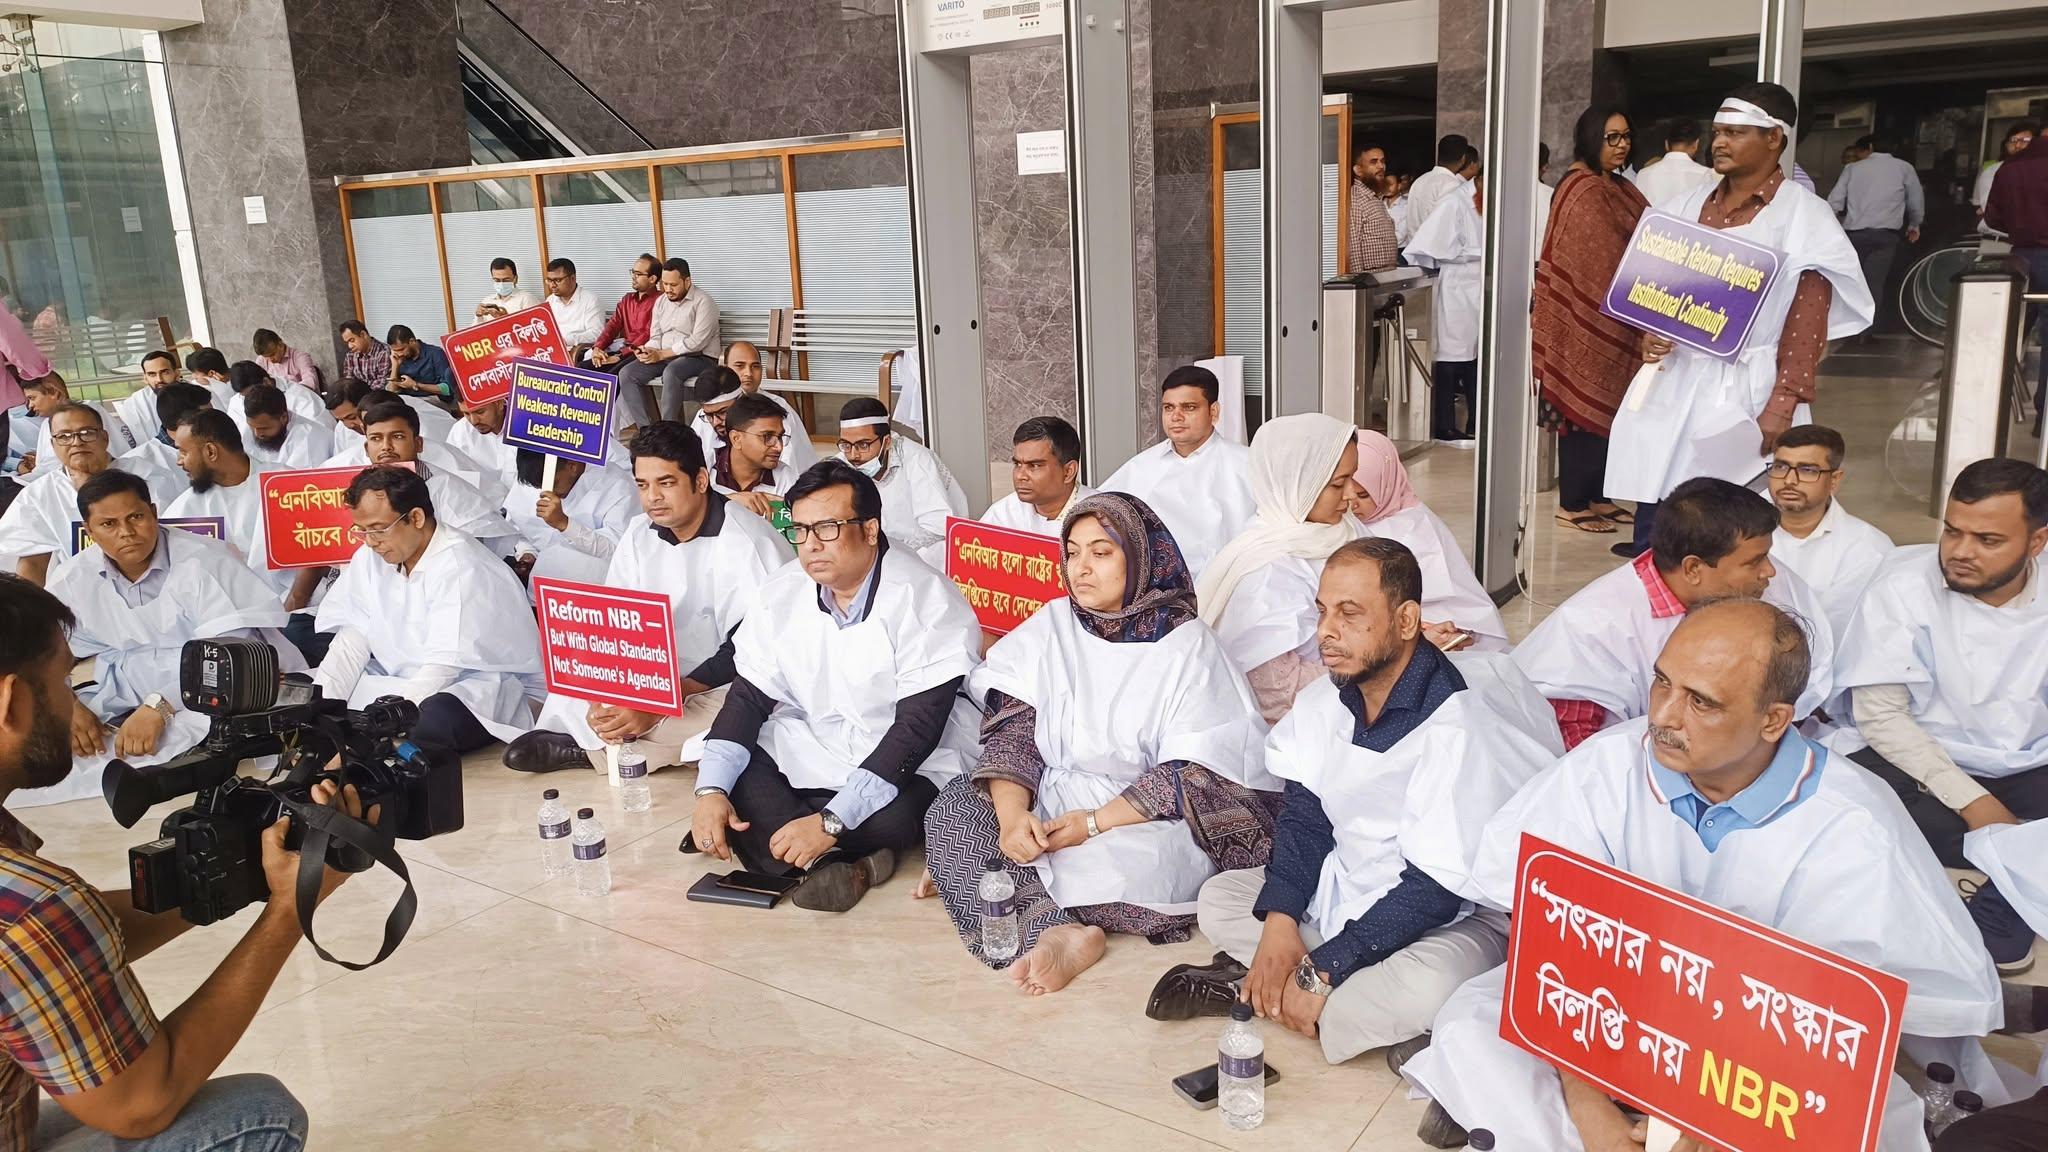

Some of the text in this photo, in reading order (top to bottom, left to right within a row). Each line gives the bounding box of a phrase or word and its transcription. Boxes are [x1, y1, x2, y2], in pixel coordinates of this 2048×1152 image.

[937, 1, 965, 11] VARITO
[1636, 224, 1765, 292] Sustainable Reform Requires
[1627, 276, 1729, 342] Institutional Continuity
[495, 331, 514, 349] এর
[512, 318, 548, 344] বিলুপ্তি
[517, 371, 606, 403] Bureaucratic Control
[517, 393, 601, 426] Weakens Revenue
[527, 419, 584, 448] Leadership
[269, 484, 347, 512] “এনবিআ
[292, 522, 343, 549] বাঁচবে
[1000, 550, 1024, 577] হলো
[1025, 552, 1053, 584] রাষ্ট্রের
[548, 598, 604, 626] Reform
[607, 607, 644, 632] NBR
[992, 591, 1010, 614] হবে
[550, 628, 667, 663] But With Global Standards
[553, 655, 671, 692] Not Someone's Agendas
[1535, 962, 1630, 1052] বিলুপ্তি
[1637, 1020, 1691, 1085] নয়
[1740, 973, 1869, 1071] সংস্কার
